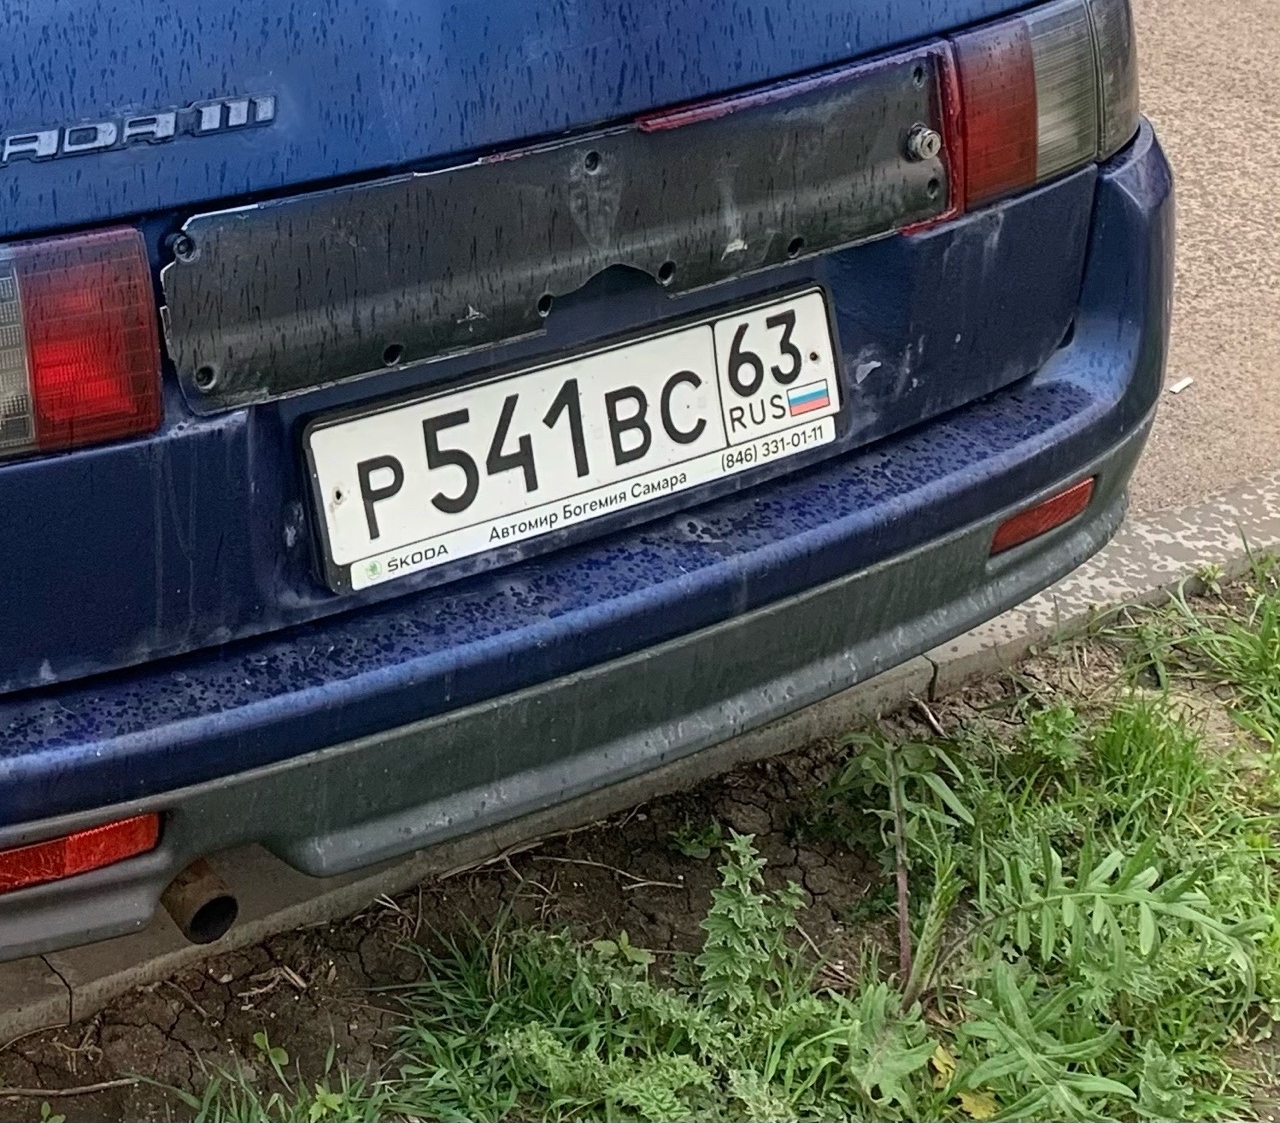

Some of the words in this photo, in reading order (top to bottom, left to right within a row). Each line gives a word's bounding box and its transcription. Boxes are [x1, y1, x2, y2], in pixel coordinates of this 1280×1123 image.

[728, 308, 803, 398] 63
[721, 444, 758, 472] (846)
[762, 425, 824, 458] 331-01-11
[729, 393, 787, 434] RUS
[356, 369, 707, 540] Р541ВС
[488, 514, 559, 543] Автомир
[562, 489, 627, 520] Богемия
[630, 470, 688, 498] Самара
